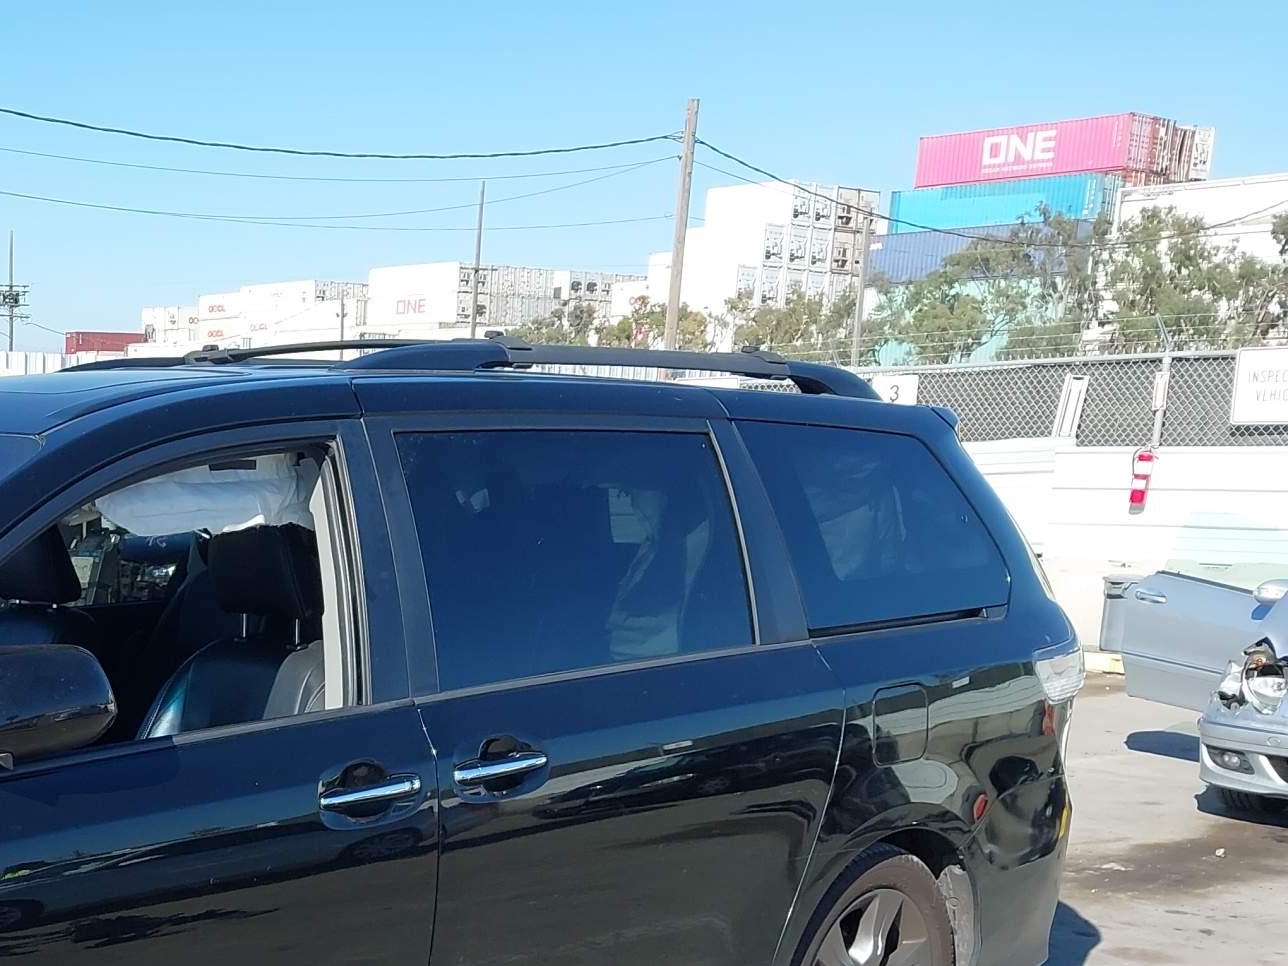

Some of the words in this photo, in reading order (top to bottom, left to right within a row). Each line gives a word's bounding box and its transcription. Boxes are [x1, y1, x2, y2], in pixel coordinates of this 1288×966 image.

[982, 130, 1057, 164] ONE
[396, 299, 426, 315] ONE
[889, 384, 900, 403] 3
